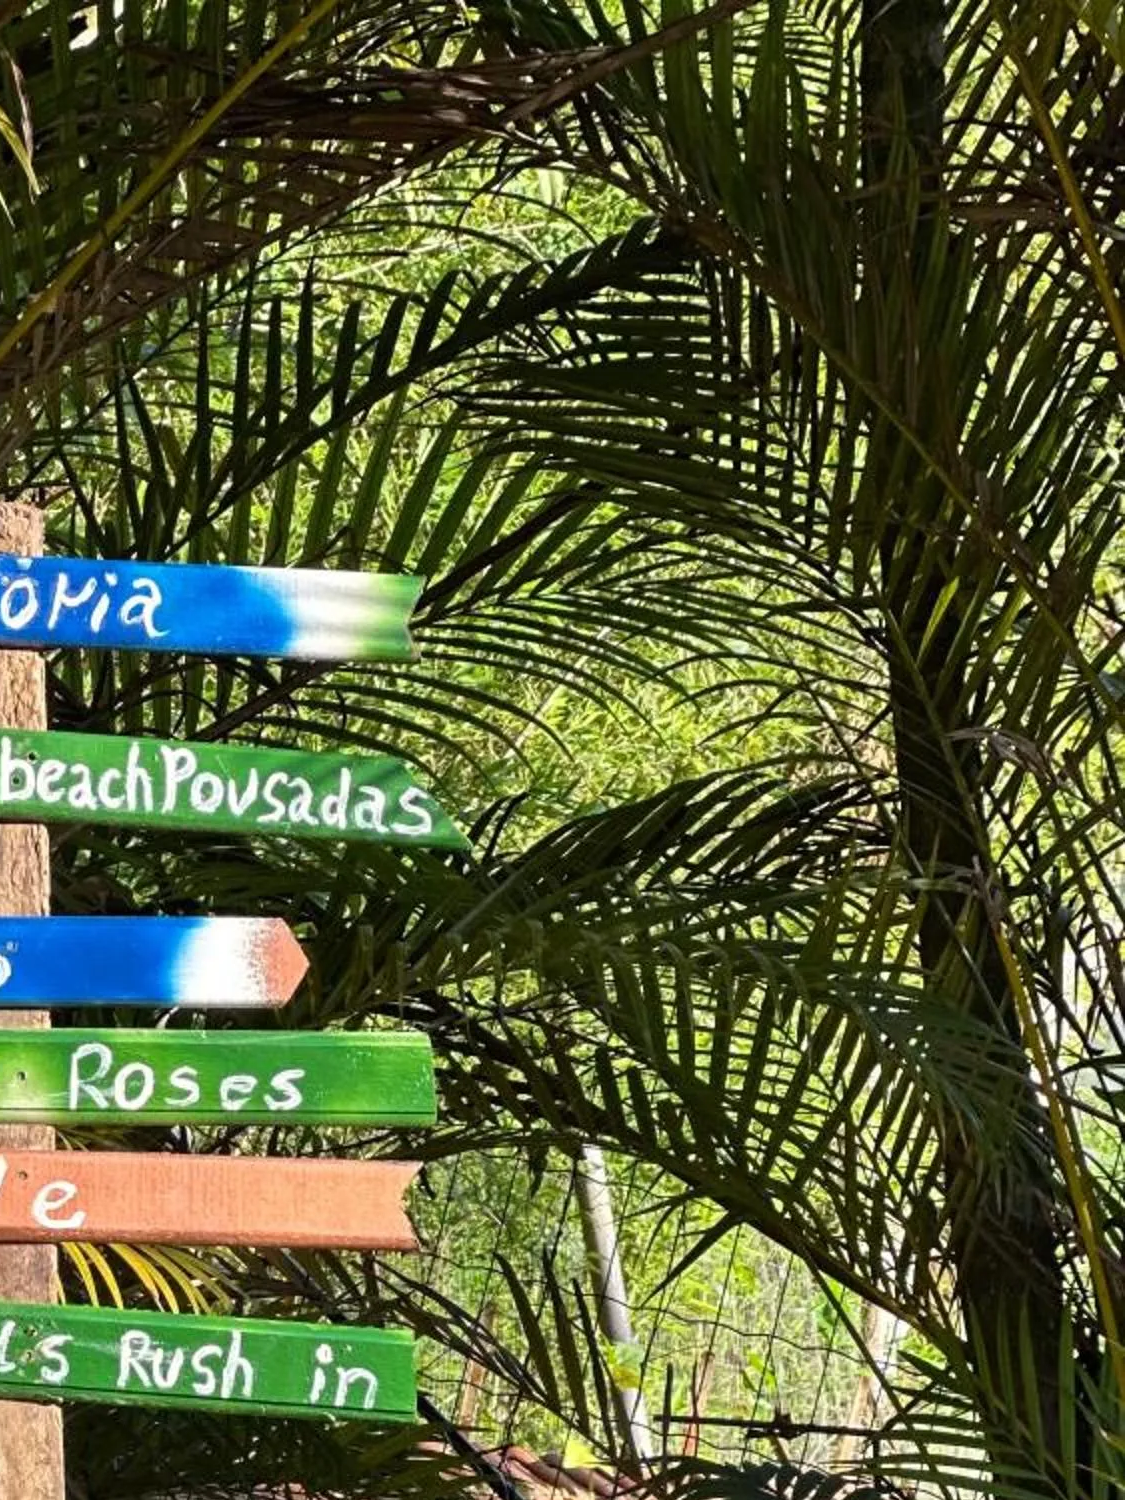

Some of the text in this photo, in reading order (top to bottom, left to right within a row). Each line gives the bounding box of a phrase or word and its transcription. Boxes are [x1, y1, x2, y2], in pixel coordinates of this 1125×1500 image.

[69, 1043, 305, 1110] Roses
[117, 1330, 255, 1398] Rush
[309, 1343, 378, 1410] in
